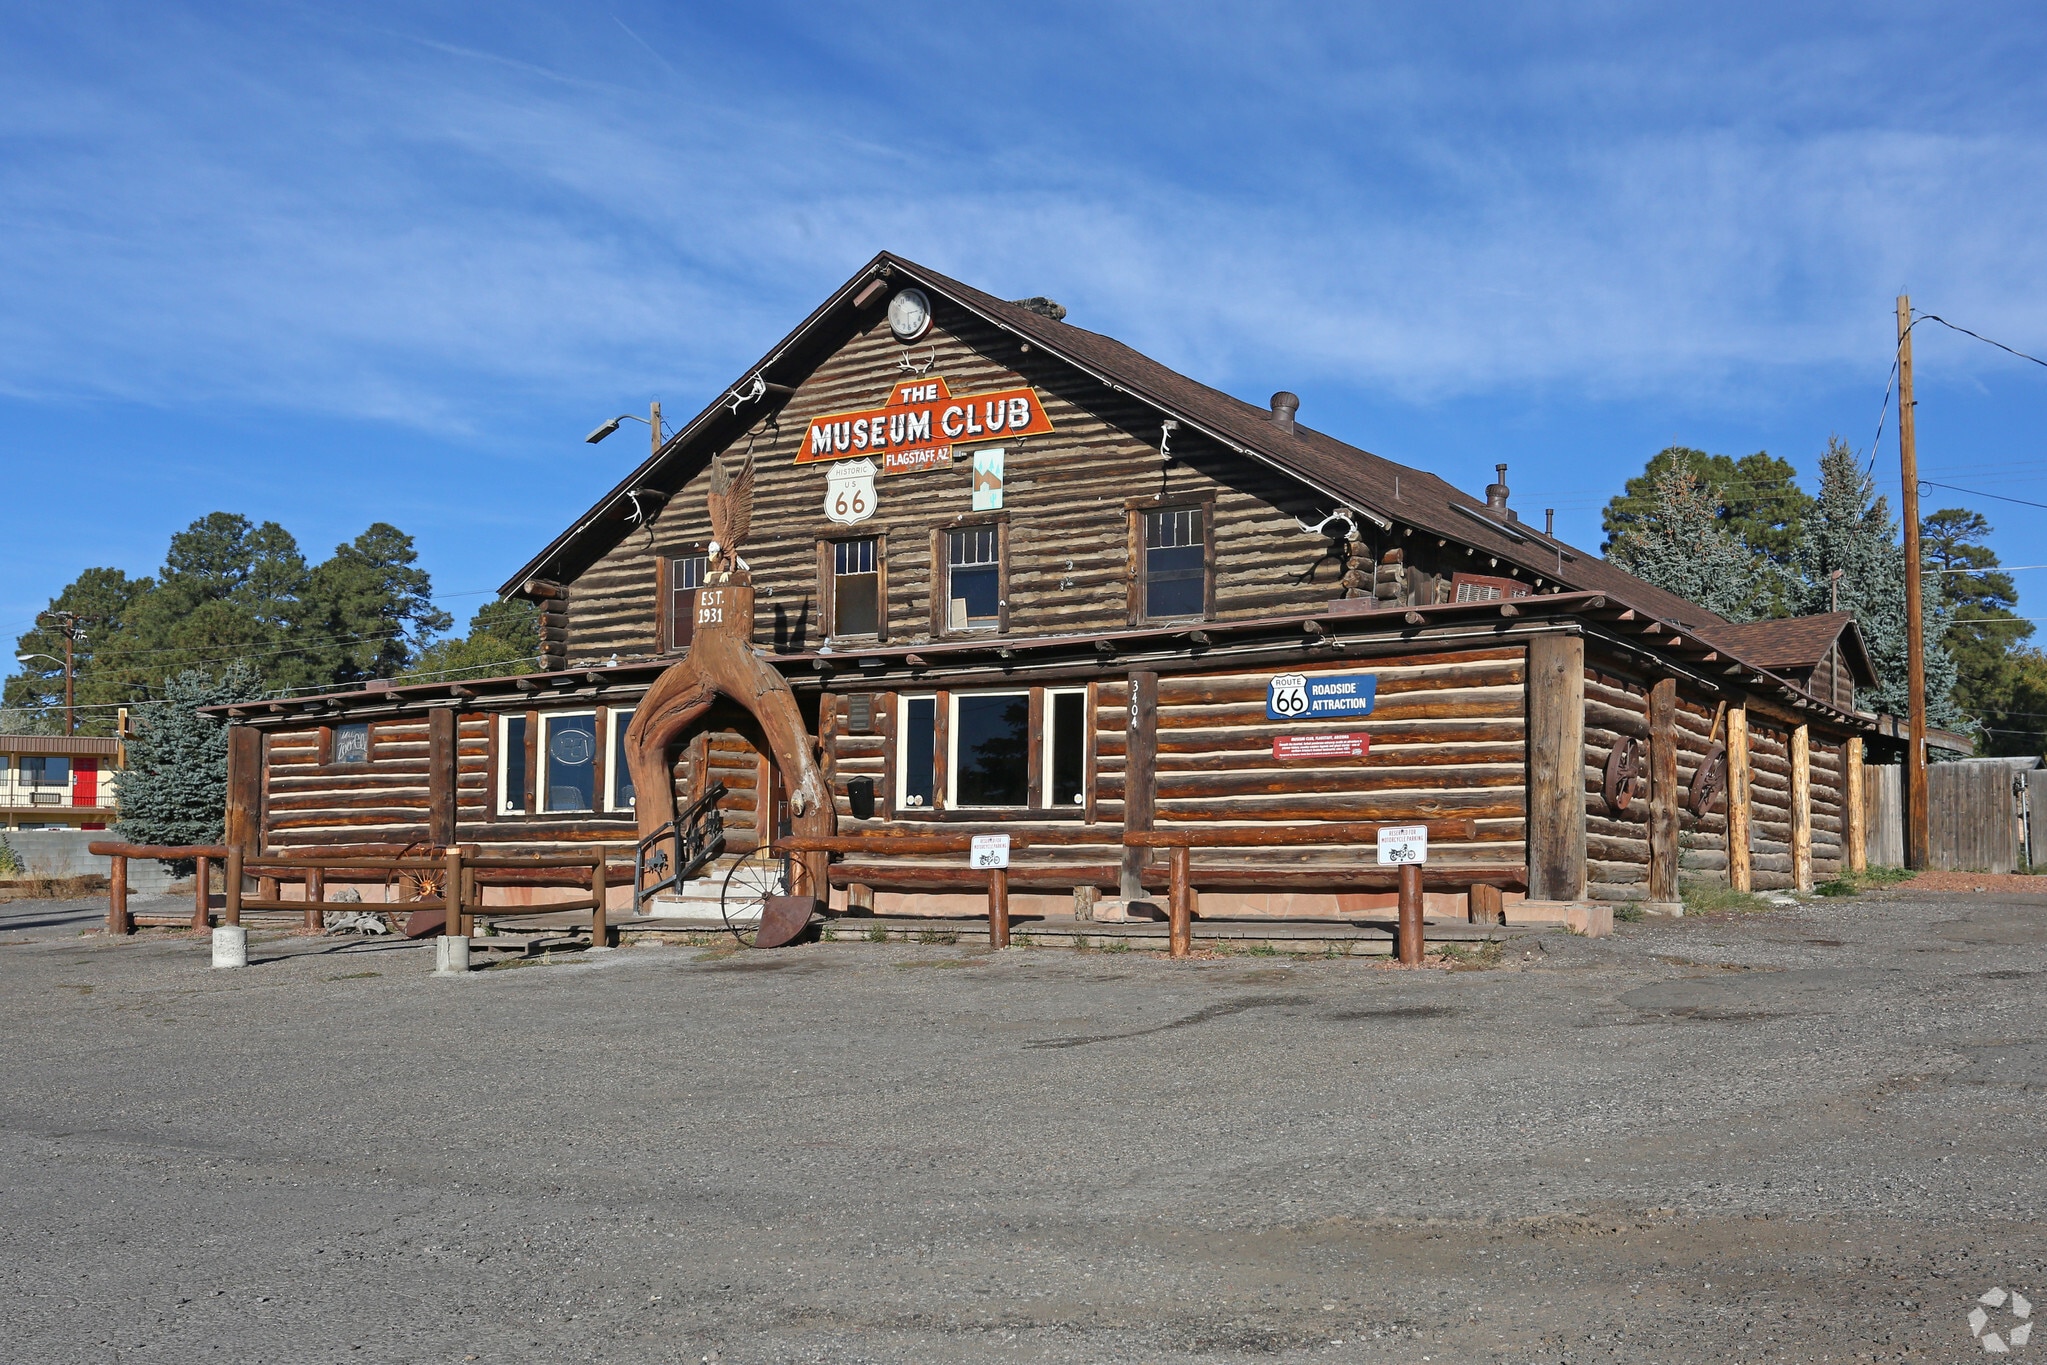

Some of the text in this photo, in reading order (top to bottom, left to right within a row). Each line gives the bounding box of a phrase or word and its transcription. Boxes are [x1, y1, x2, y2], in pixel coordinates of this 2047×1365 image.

[900, 383, 938, 404] THE
[811, 397, 1031, 454] MUSEUM CLUB
[886, 448, 950, 467] FLAGSTAFF, AZ
[835, 465, 868, 476] HISTORIC
[844, 480, 857, 489] US
[835, 489, 865, 516] 66
[701, 590, 725, 606] EST.
[698, 608, 723, 624] 1931
[1275, 678, 1302, 686] ROUTE
[1312, 683, 1356, 696] ROADSIDE
[1131, 679, 1139, 729] 3404
[1276, 689, 1304, 713] 66
[1312, 697, 1367, 711] ATTRACTION
